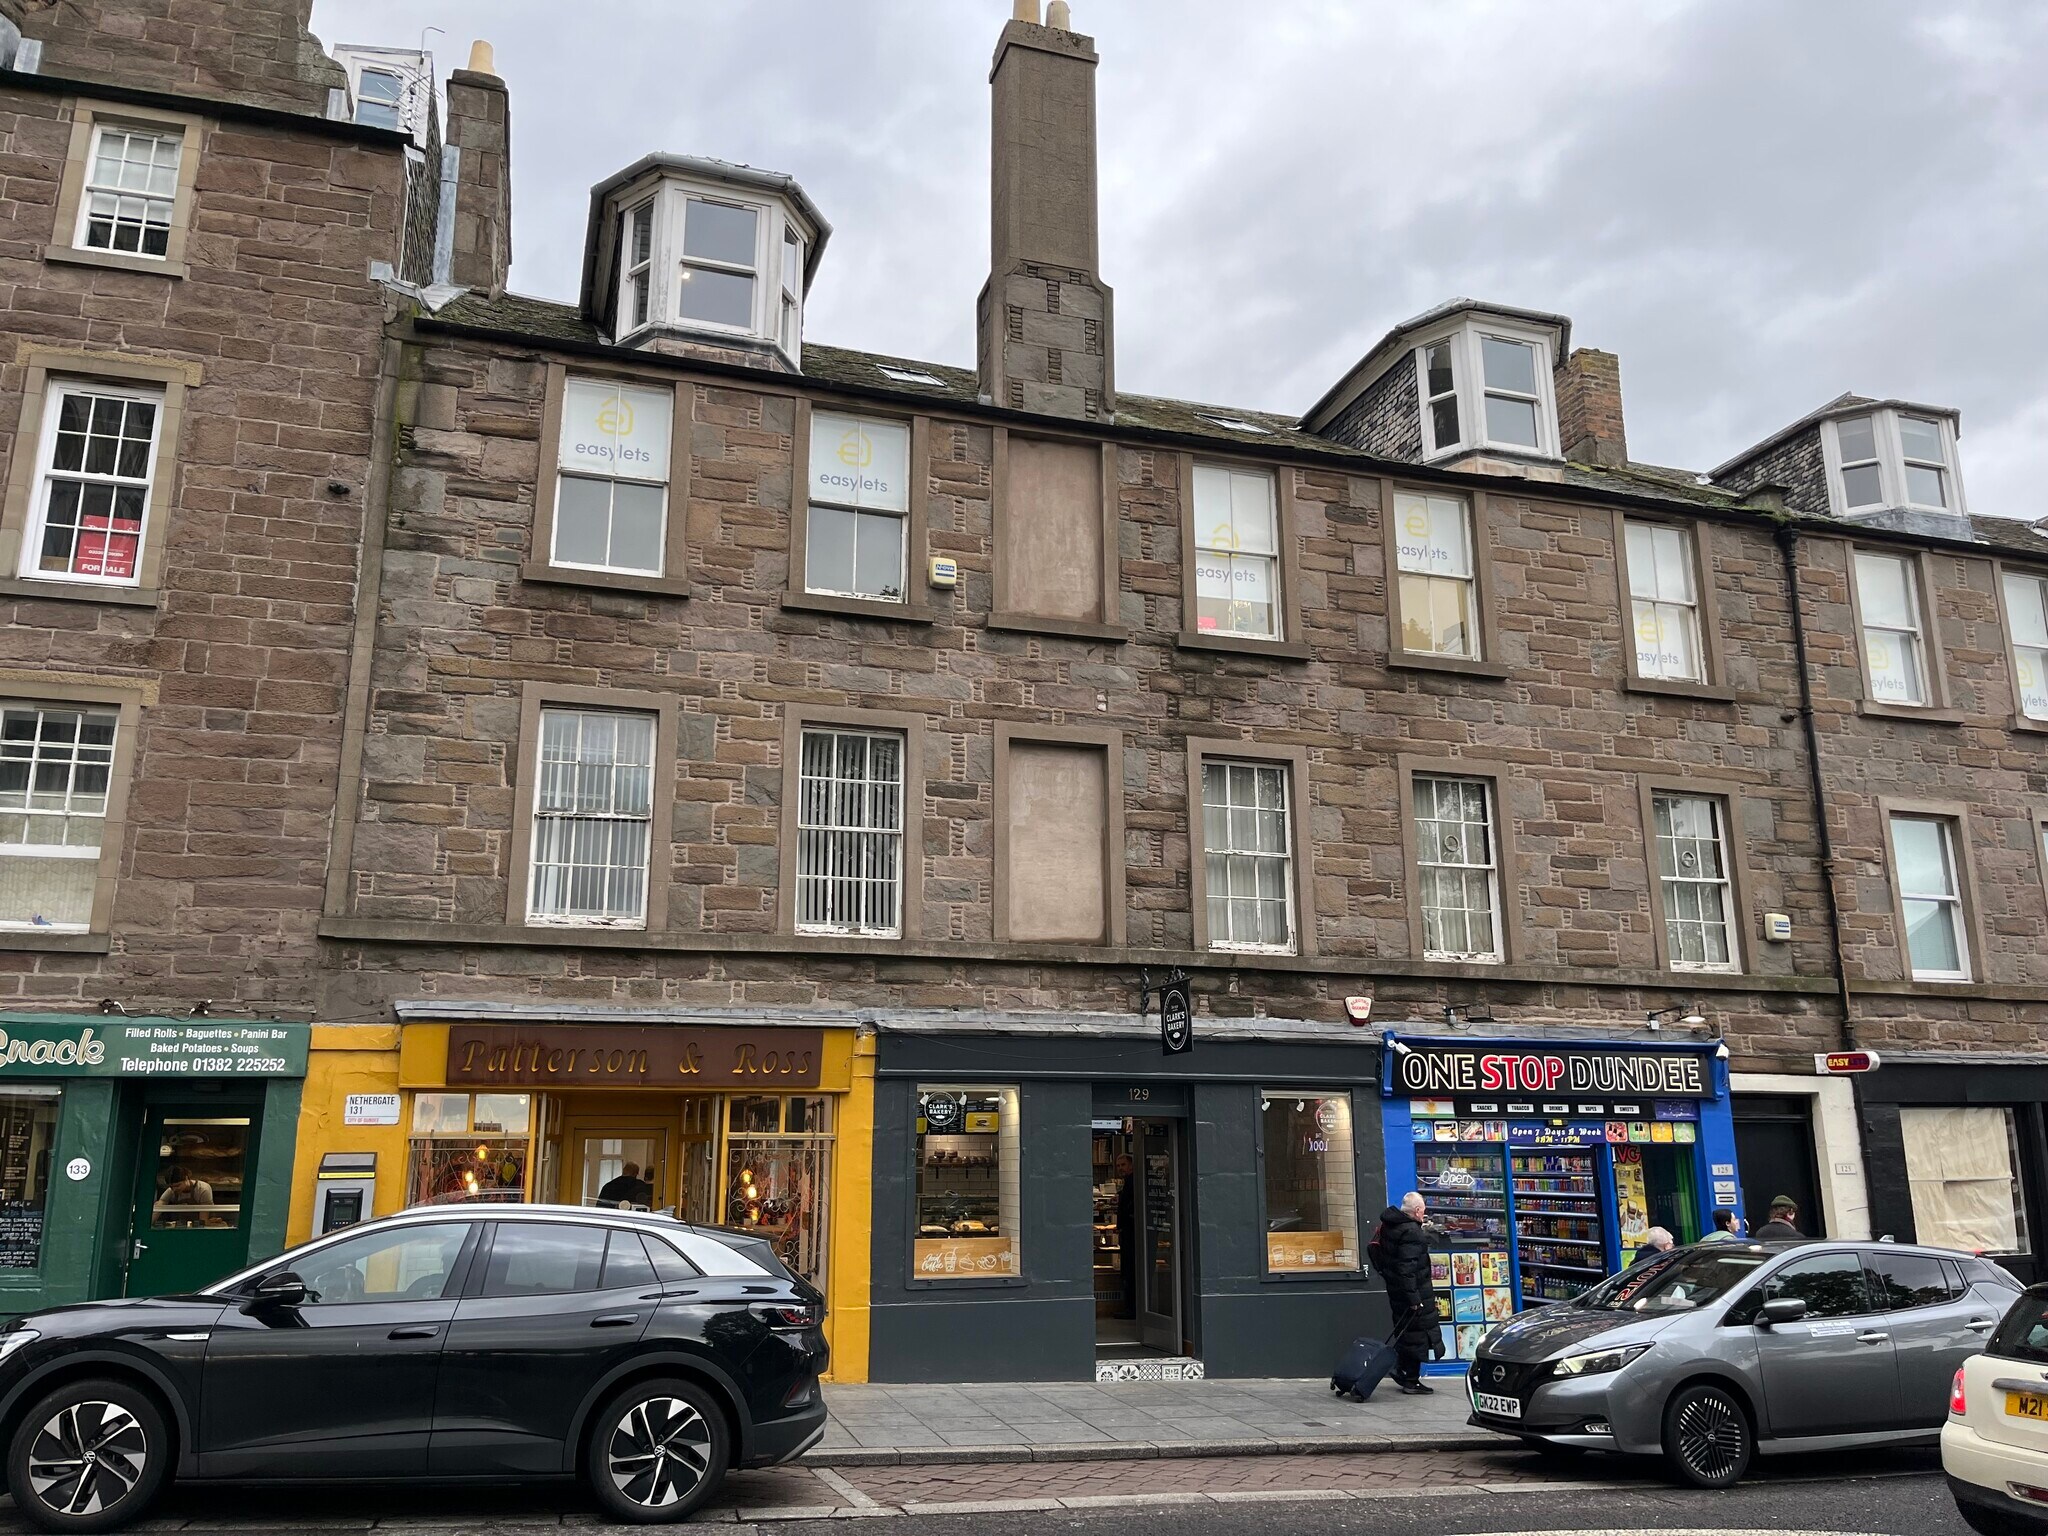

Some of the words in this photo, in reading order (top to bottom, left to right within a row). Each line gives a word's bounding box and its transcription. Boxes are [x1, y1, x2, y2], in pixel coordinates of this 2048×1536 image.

[575, 443, 650, 462] easylets
[820, 473, 888, 493] easylets
[82, 563, 100, 572] FOR
[1196, 567, 1256, 583] easyets
[1637, 652, 1679, 666] asyets
[1871, 676, 1905, 691] sylets
[2022, 694, 2048, 709] ylets
[1166, 1011, 1185, 1022] CLARK'S
[1167, 1020, 1185, 1031] BAKERY
[125, 1028, 151, 1038] Filled
[153, 1028, 178, 1038] Rolls
[185, 1028, 232, 1040] Baguettes
[240, 1029, 269, 1039] Panini
[271, 1030, 287, 1039] Bar
[150, 1043, 180, 1053] Baked
[182, 1043, 222, 1053] Potatoes
[230, 1043, 259, 1055] Soups
[461, 1039, 649, 1074] Patterson
[678, 1041, 703, 1074] &
[731, 1042, 813, 1075] Ross
[1827, 1058, 1849, 1067] EASY
[120, 1057, 188, 1074] Telephone
[192, 1058, 232, 1072] 01382
[237, 1058, 286, 1072] 225252
[1402, 1053, 1475, 1091] ONE
[1480, 1054, 1565, 1091] STOP
[1569, 1055, 1703, 1093] DUNDEE
[349, 1096, 396, 1105] NETHERGATE
[1128, 1088, 1150, 1101] 129
[350, 1105, 363, 1115] 131
[1512, 1127, 1533, 1136] Open
[1535, 1128, 1540, 1136] 7
[1545, 1127, 1566, 1137] Days
[1568, 1128, 1575, 1136] A
[1579, 1128, 1601, 1136] Week
[69, 1164, 88, 1175] 133
[1716, 1166, 1729, 1174] 125
[1443, 1171, 1469, 1187] Open
[1479, 1395, 1499, 1411] GK22
[1500, 1398, 1518, 1413] EWP
[2019, 1397, 2043, 1416] M21
